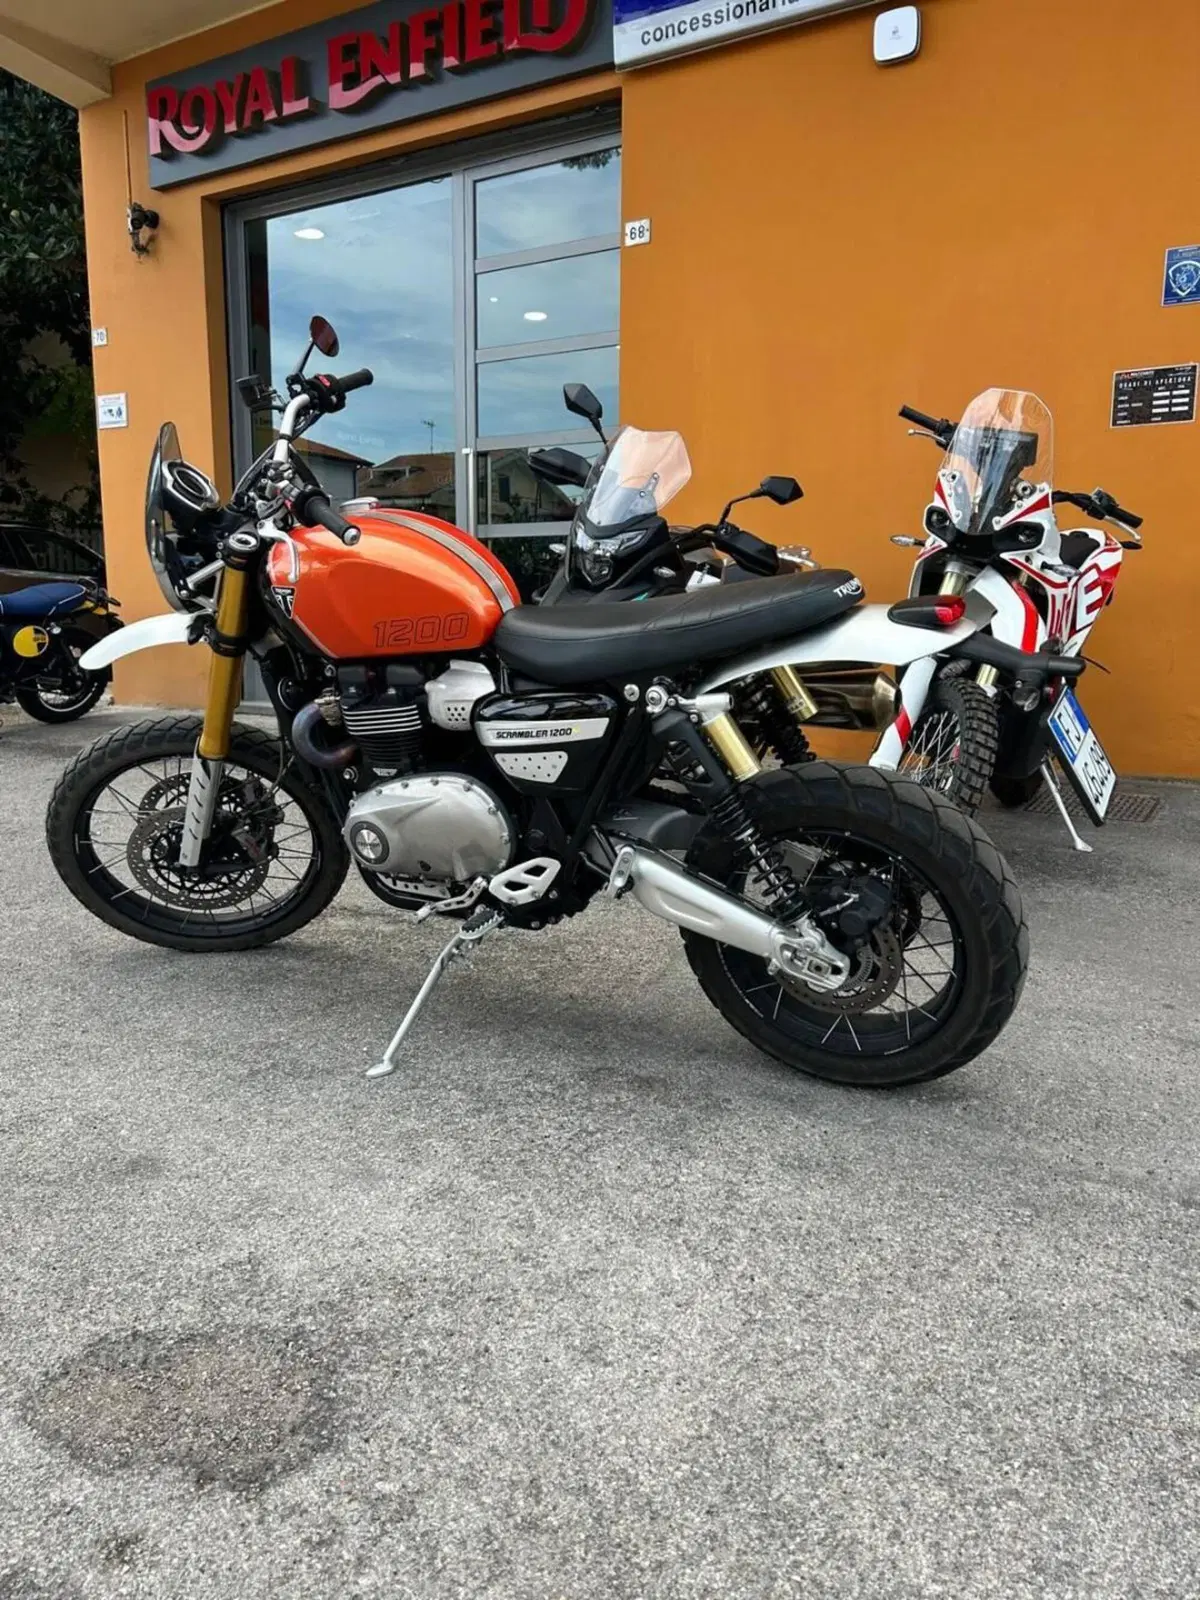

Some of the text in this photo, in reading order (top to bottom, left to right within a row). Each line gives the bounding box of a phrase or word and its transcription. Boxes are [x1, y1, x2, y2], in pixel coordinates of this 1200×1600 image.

[641, 0, 800, 45] concessionar
[147, 0, 588, 155] ROYAL ENFIELD
[629, 224, 646, 240] 68
[373, 612, 470, 648] 1200
[496, 730, 548, 739] SCRAMBLER
[549, 727, 573, 737] 1200
